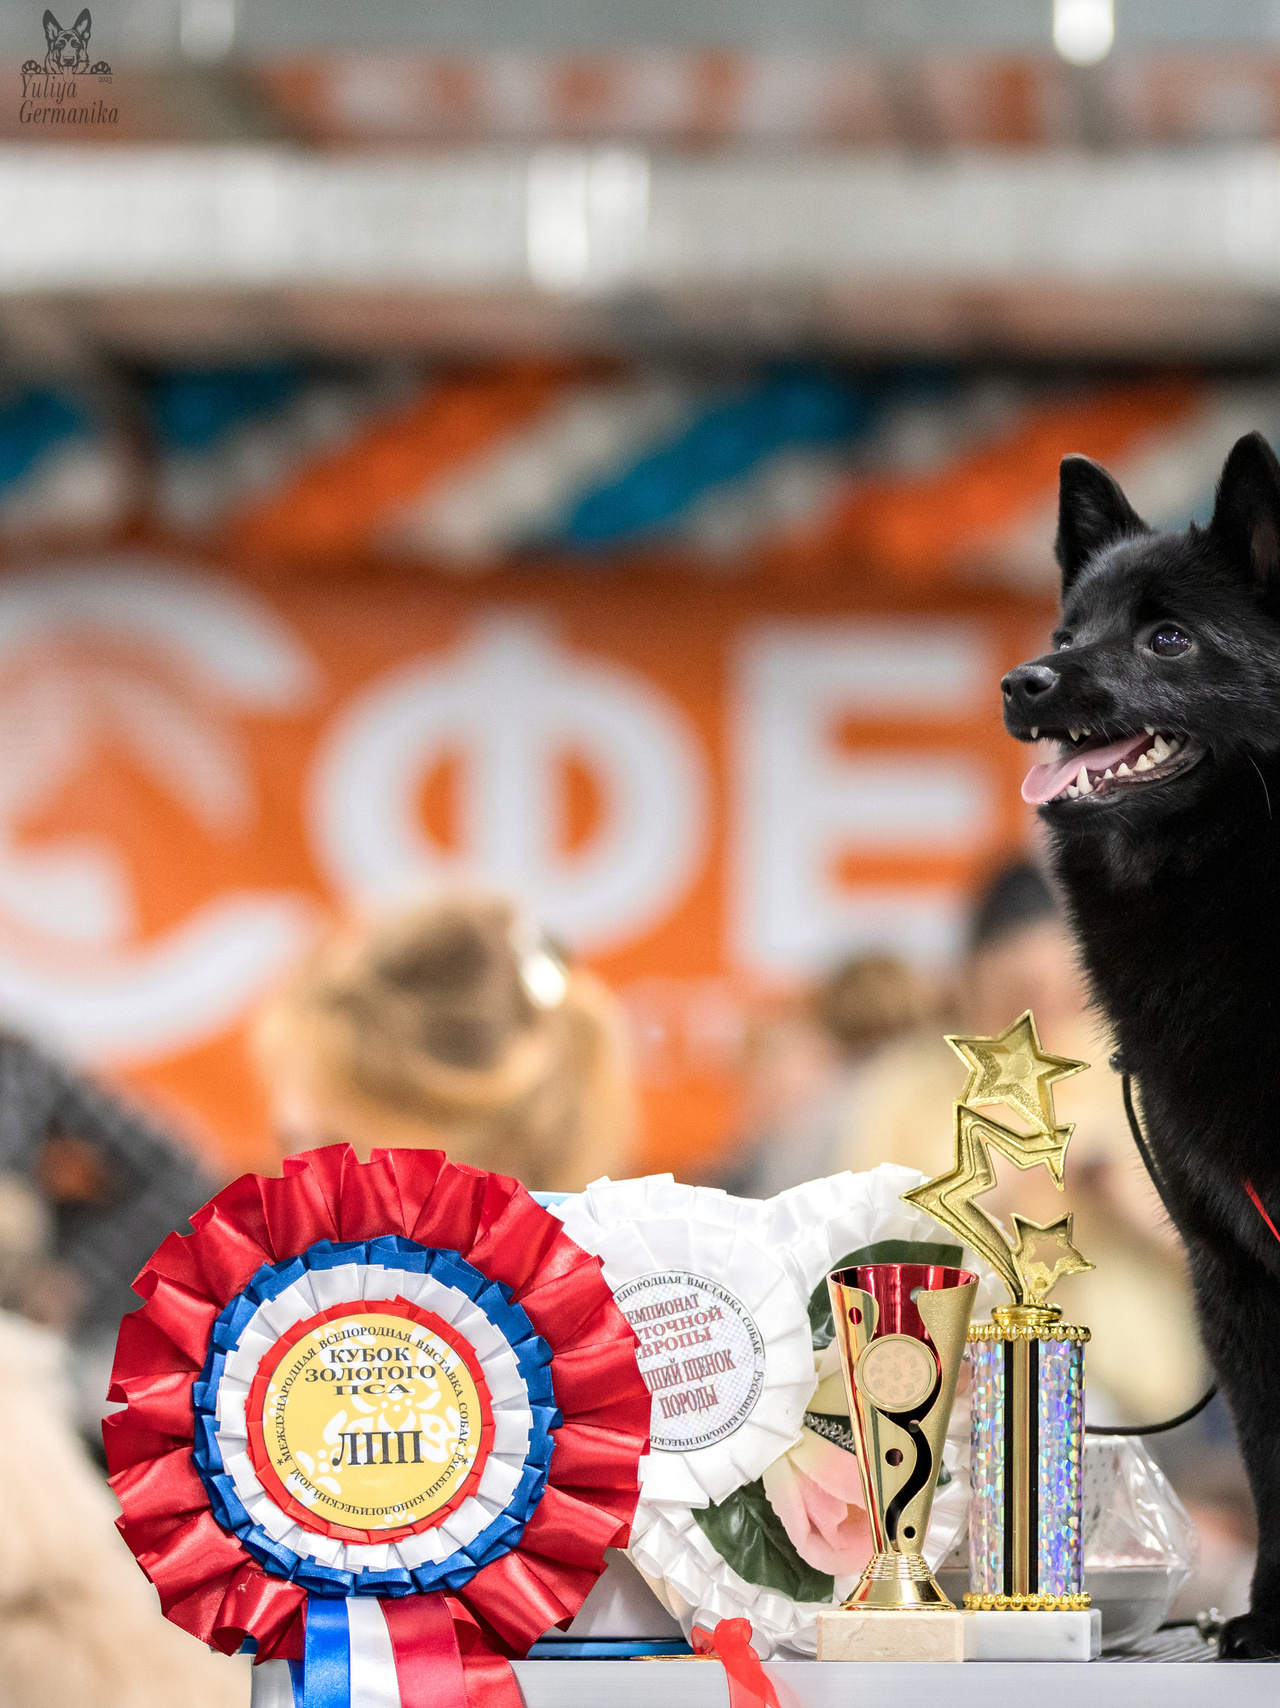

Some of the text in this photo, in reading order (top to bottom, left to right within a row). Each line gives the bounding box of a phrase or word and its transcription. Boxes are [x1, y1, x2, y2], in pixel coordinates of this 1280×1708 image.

[616, 1276, 762, 1355] ЕПОРОДНАЯ ВЫСТАВКА СОБАК
[625, 1293, 699, 1324] ЕМПИОНАТ
[329, 1347, 410, 1364] КУБОК
[642, 1348, 736, 1392] ШИЙ ЩЕНОК
[305, 1365, 436, 1383] ЗОЛОТОГО
[334, 1384, 413, 1395] ПСА
[275, 1326, 469, 1462] МЕЖДУНАРОДНАЯ ВСЕПОРОДНАЯ ВЫСТАВКА СОБАК
[650, 1370, 764, 1447] РУССКИЙ КИНОЛОГИЧЕСКИ
[659, 1384, 719, 1419] ПОРОДЫ
[332, 1431, 424, 1466] ЛПП
[290, 1452, 464, 1516] РУССКИЙ КИНОЛОГИЧЕСКИЙ ДОМ
